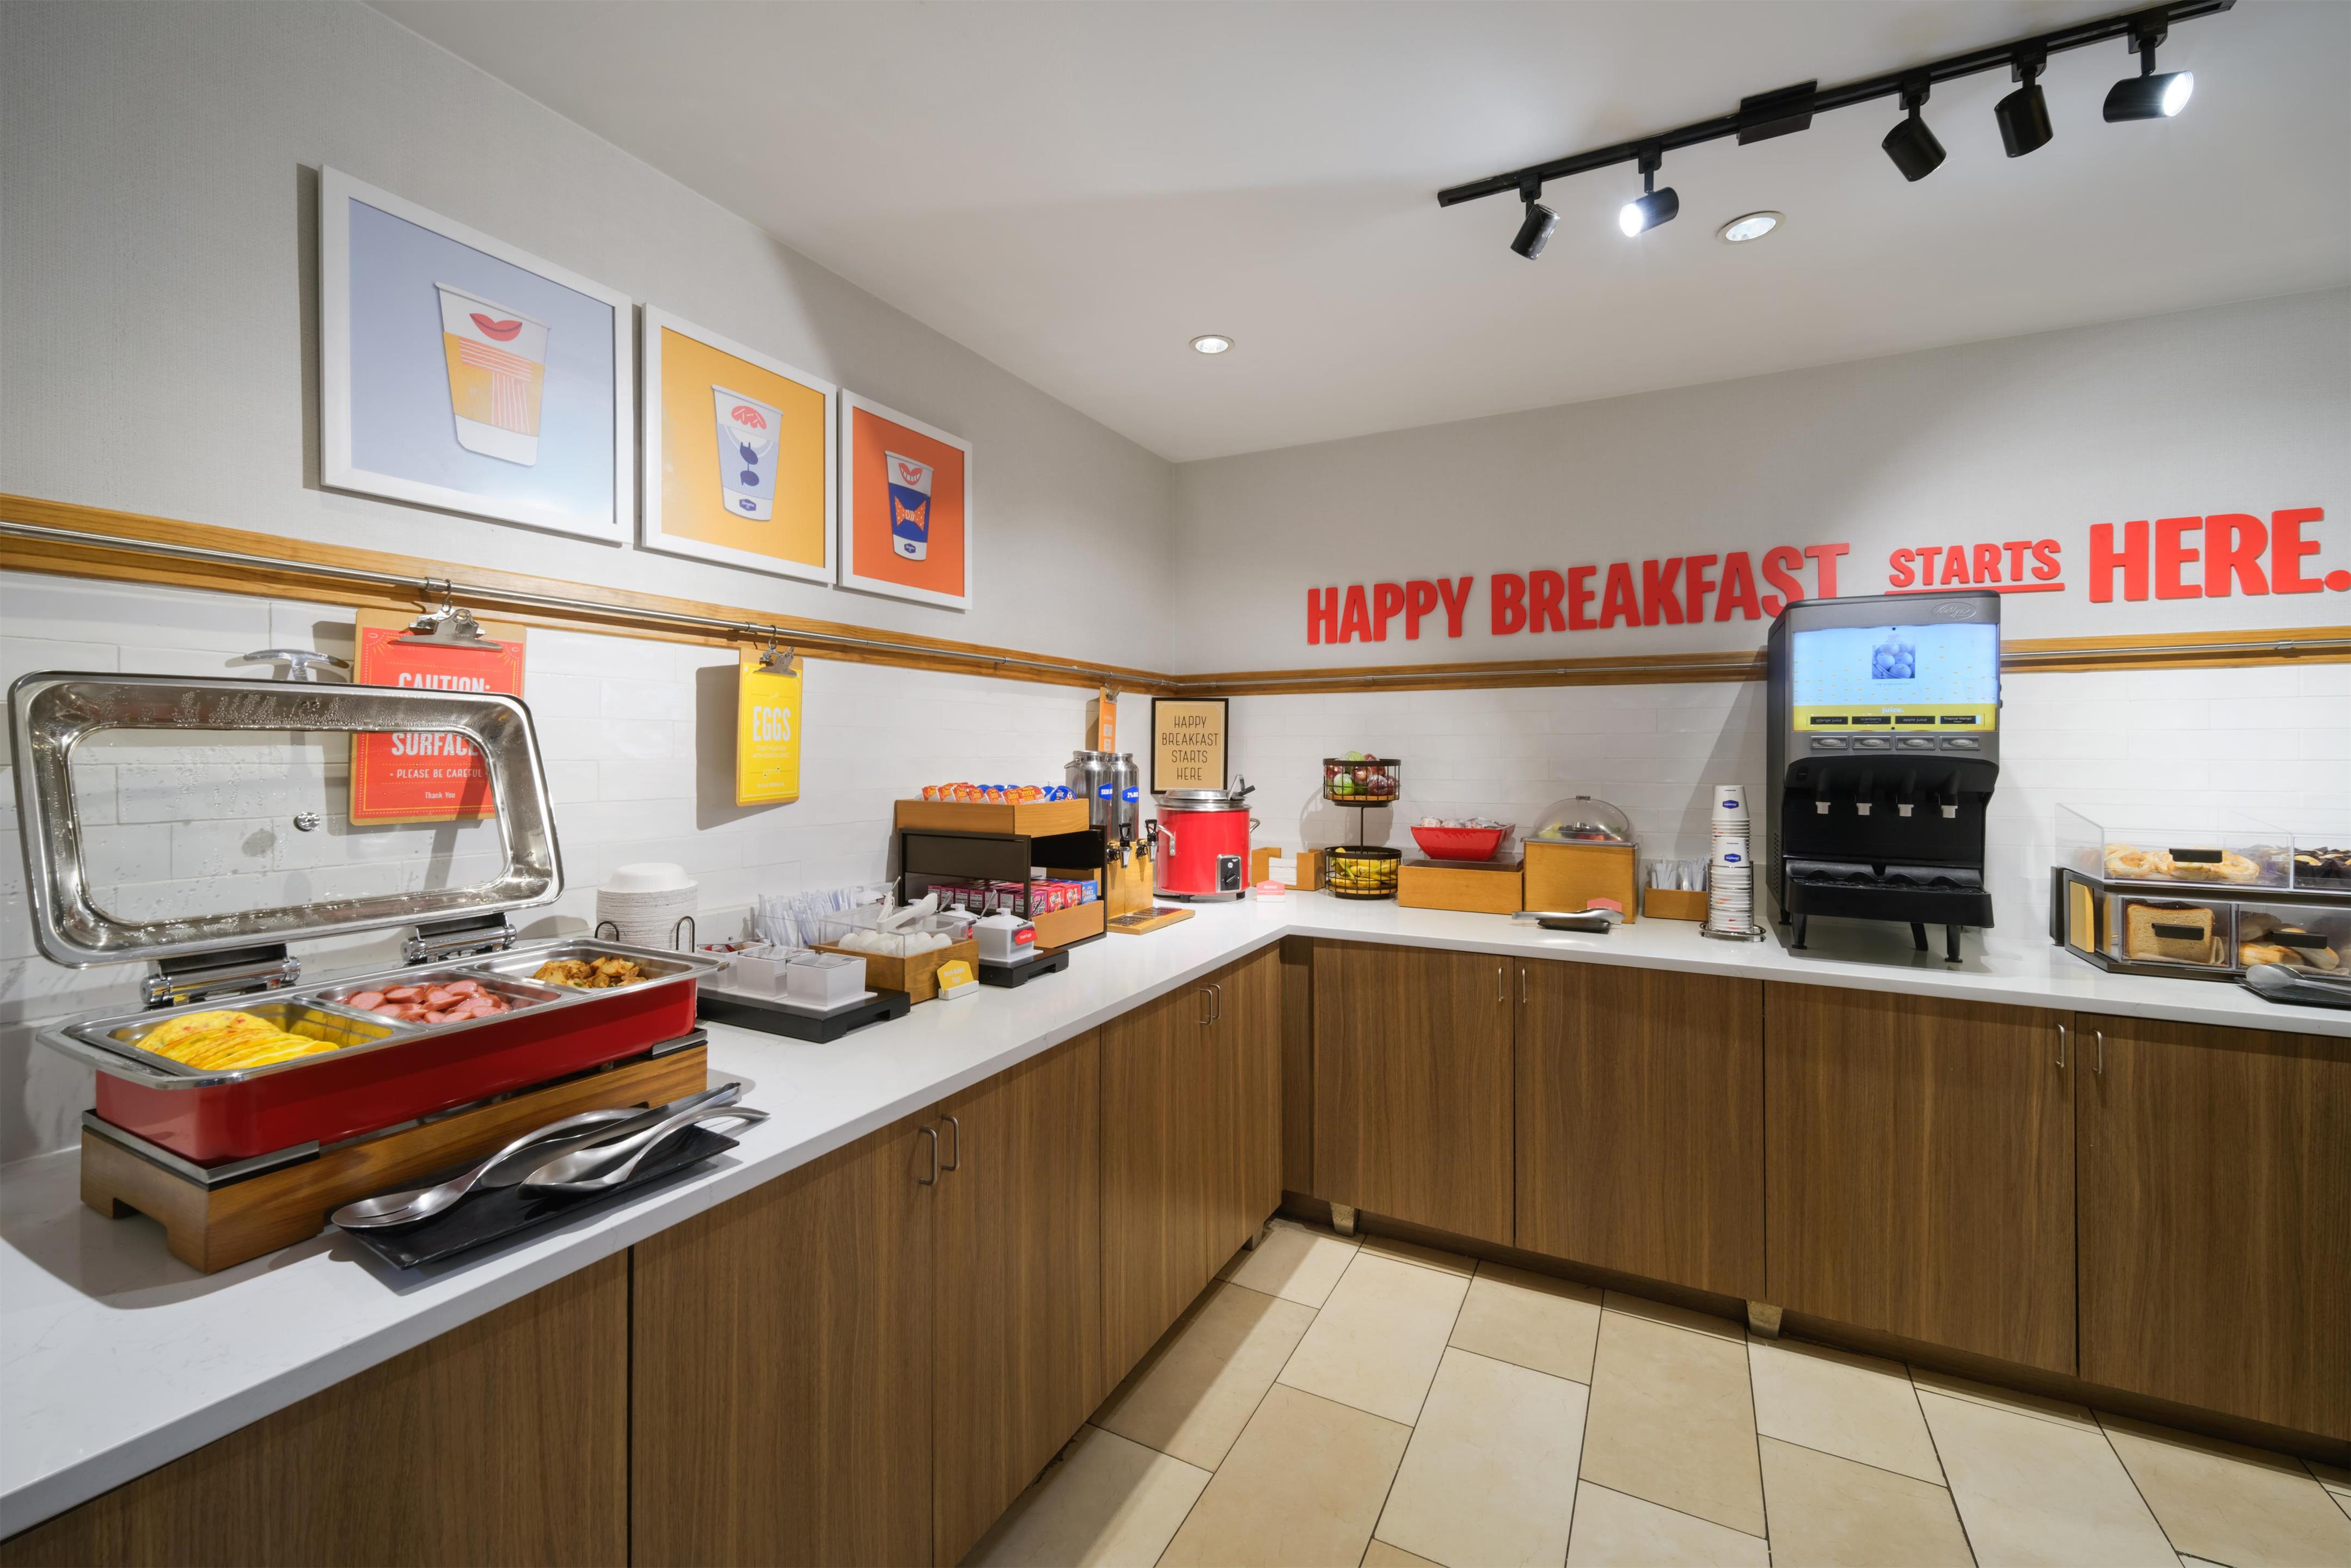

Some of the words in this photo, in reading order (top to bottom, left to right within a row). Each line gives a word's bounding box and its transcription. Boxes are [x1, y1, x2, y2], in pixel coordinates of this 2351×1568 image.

[1307, 577, 1473, 645] HAPPY
[1491, 543, 1850, 635] BREAKFAST
[1889, 539, 2061, 587] STARTS
[2089, 507, 2351, 603] HERE.
[753, 706, 791, 742] EGGS
[1174, 715, 1207, 728] HAPPY
[1162, 732, 1219, 746] BREAKFAST
[1171, 750, 1208, 763] STARTS
[396, 769, 430, 778] PLEASE
[433, 769, 443, 778] BE
[446, 769, 482, 778] CAREFUL
[1177, 767, 1202, 780] HERE
